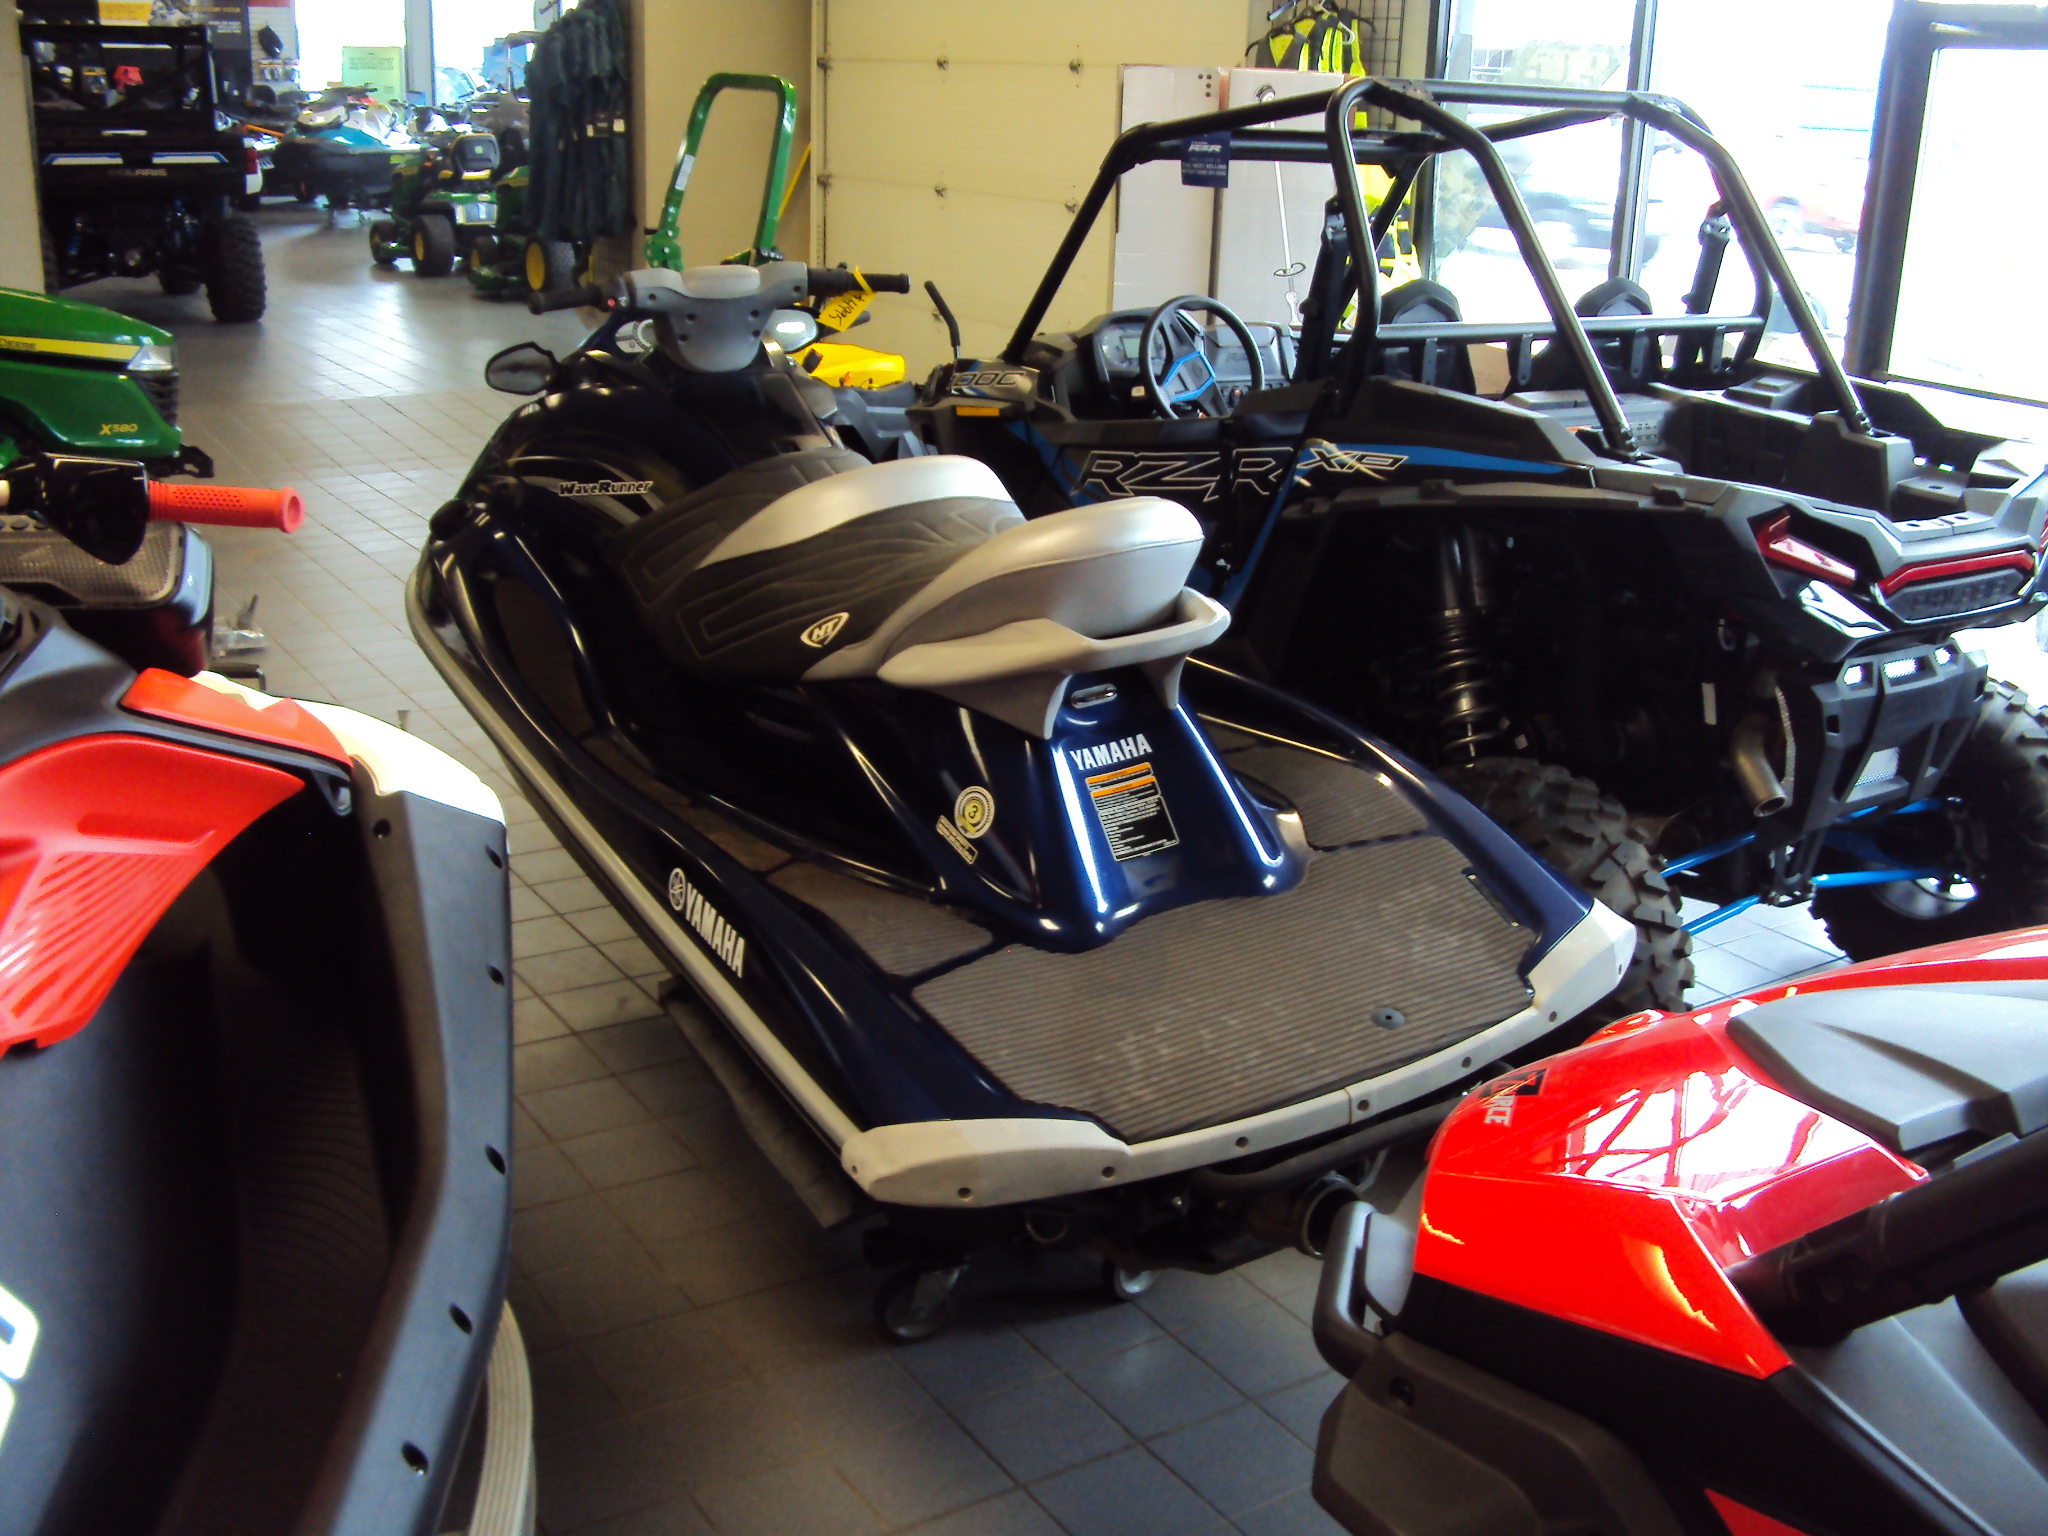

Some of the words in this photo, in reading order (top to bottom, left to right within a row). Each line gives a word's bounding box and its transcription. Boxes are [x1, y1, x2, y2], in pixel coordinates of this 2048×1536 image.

[559, 480, 654, 497] WaveRunner
[1069, 447, 1294, 503] RZR
[1069, 733, 1153, 771] YAMAHA
[685, 882, 746, 979] YAMAHA
